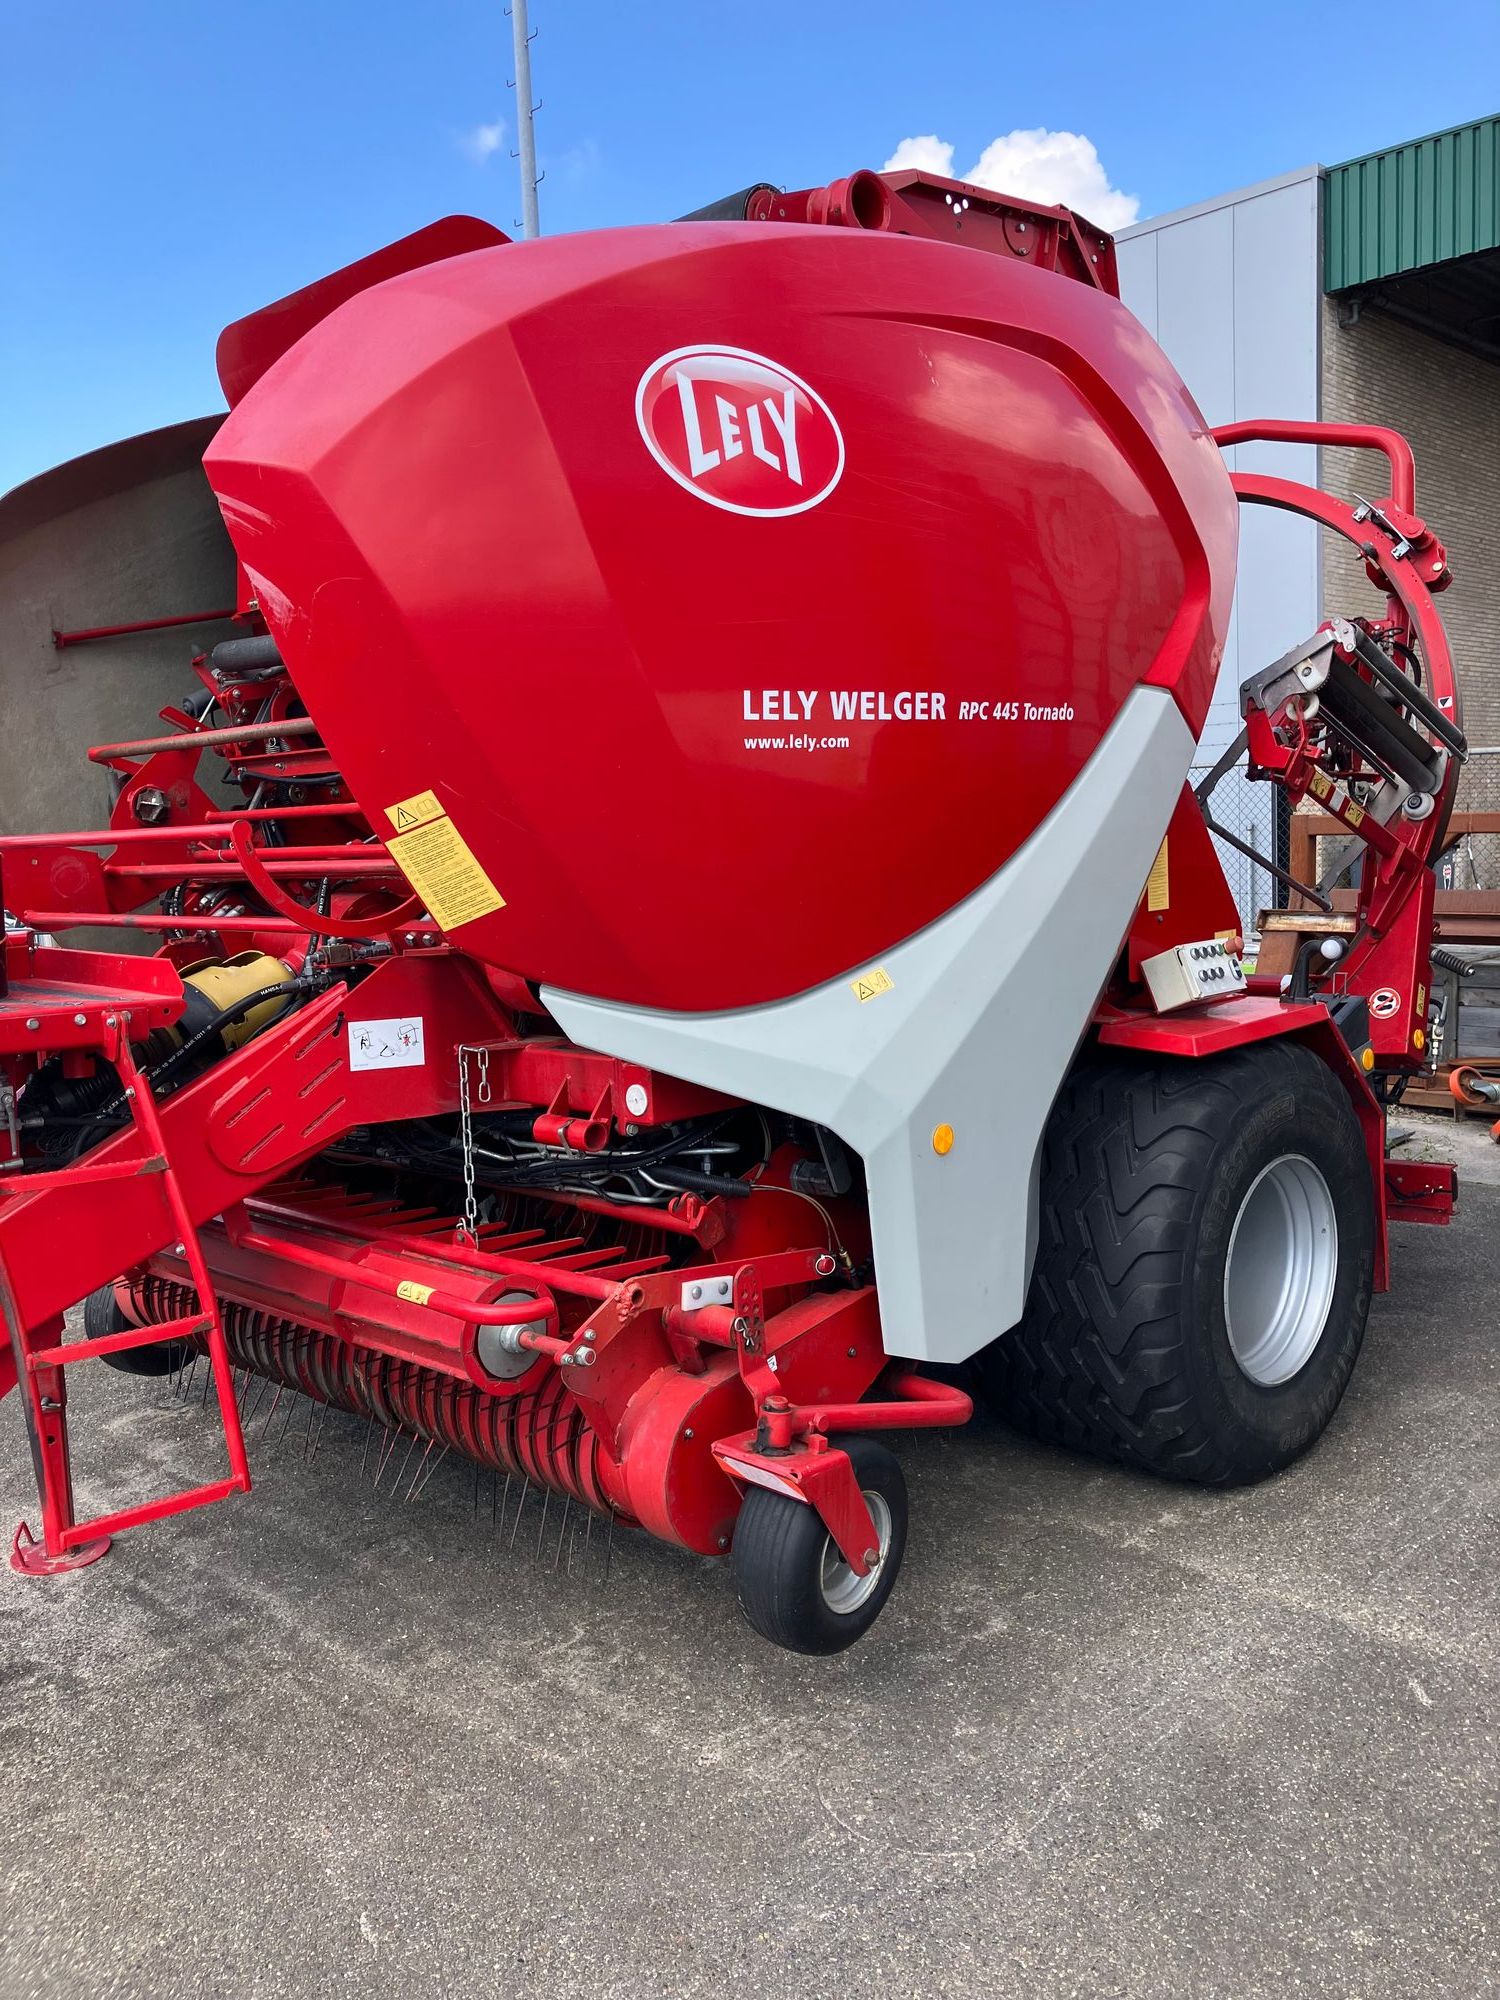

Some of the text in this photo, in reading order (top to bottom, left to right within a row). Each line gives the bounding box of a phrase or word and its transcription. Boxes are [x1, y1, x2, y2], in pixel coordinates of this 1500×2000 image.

[676, 371, 803, 487] LELY
[743, 689, 1075, 721] LELY WELGER RPC 445 Tornado
[743, 733, 850, 752] www.lely.com
